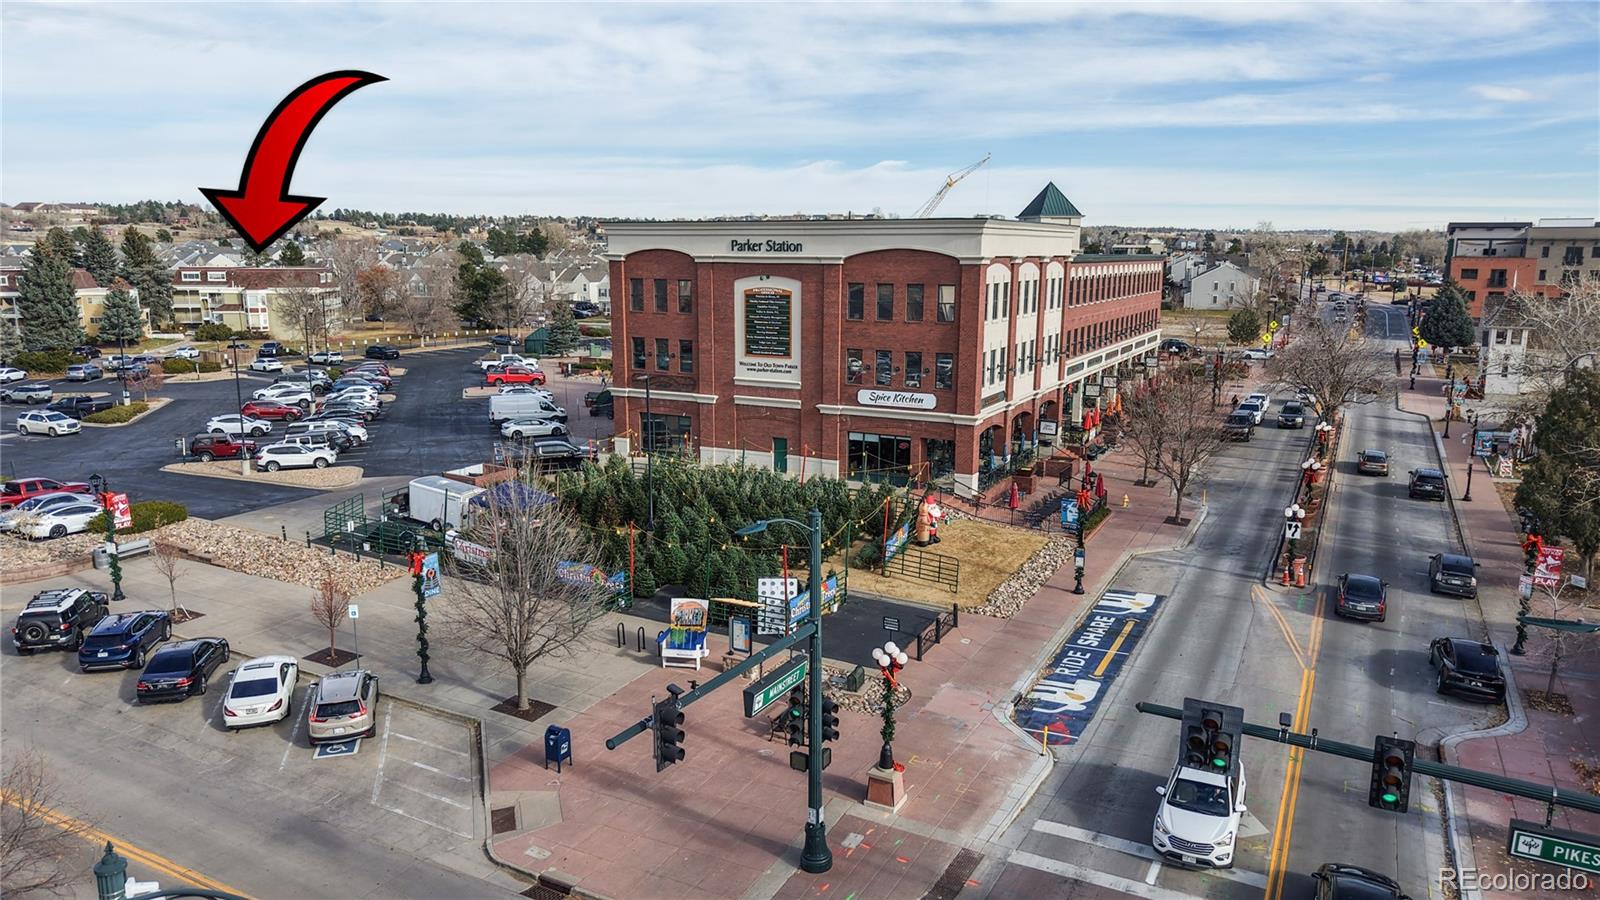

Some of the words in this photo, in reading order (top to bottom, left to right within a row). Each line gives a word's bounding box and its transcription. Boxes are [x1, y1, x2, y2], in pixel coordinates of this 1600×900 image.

[731, 239, 763, 252] Parker
[765, 239, 803, 252] Station
[869, 391, 891, 403] Spice
[893, 393, 924, 404] Kitchen
[424, 586, 440, 597] DINE
[1077, 616, 1116, 647] SHARE
[769, 670, 800, 699] MAINSTREET
[1553, 845, 1600, 867] PIKES
